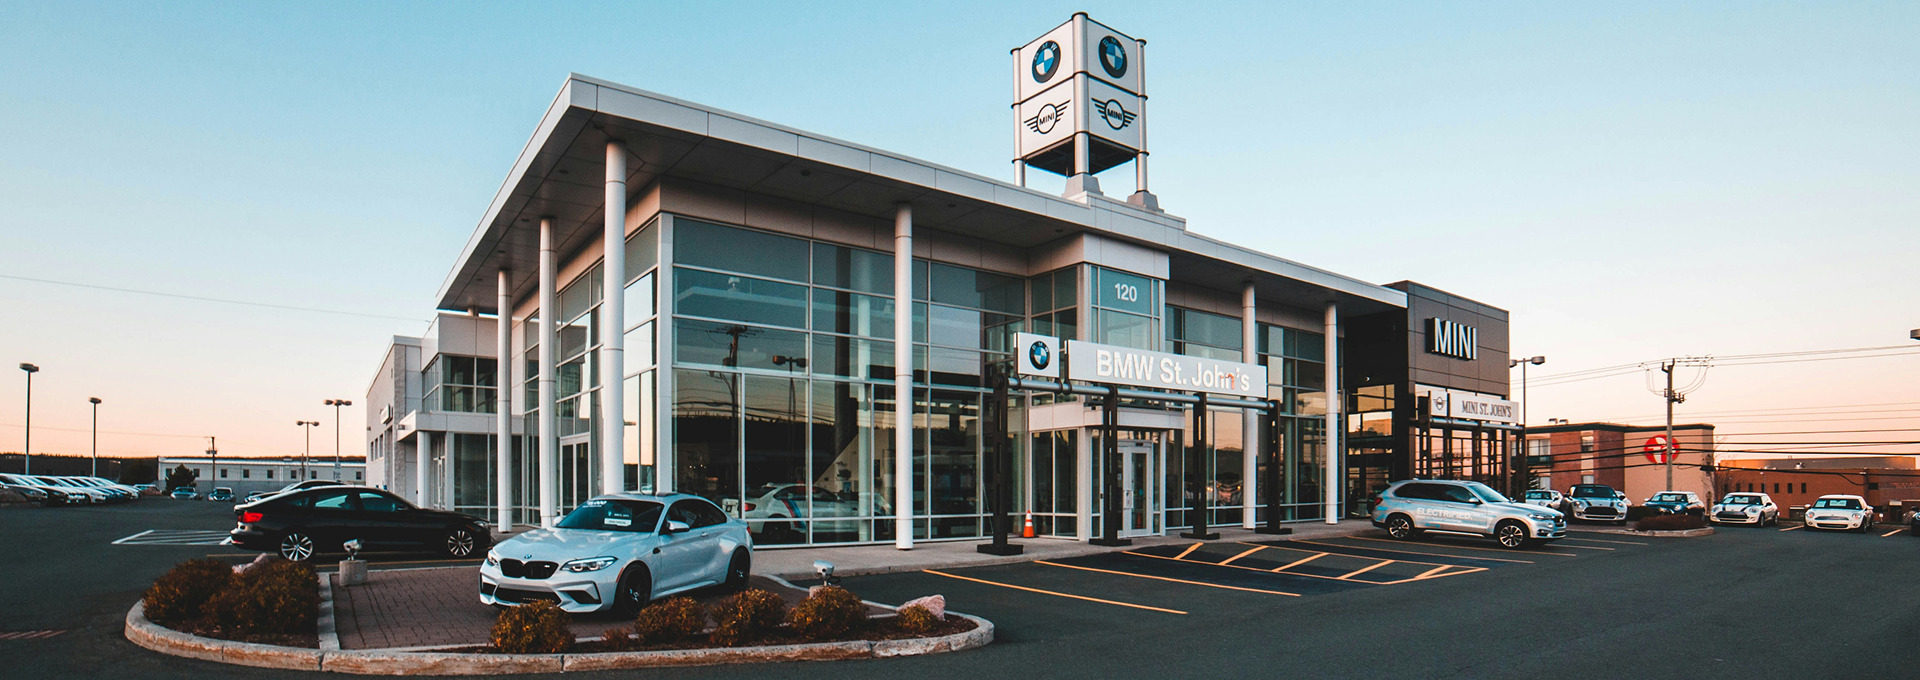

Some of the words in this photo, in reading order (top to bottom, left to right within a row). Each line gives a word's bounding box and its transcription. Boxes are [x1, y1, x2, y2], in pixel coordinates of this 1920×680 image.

[1039, 111, 1055, 126] MINI
[1107, 108, 1123, 121] MINI
[1114, 283, 1138, 302] 120
[1431, 317, 1477, 360] MINI
[1096, 349, 1155, 382] BMW
[1159, 357, 1187, 385] St.
[1191, 362, 1250, 391] John's
[1461, 400, 1479, 414] MINI
[1479, 402, 1488, 415] ST.
[1490, 404, 1512, 417] JOHN'S
